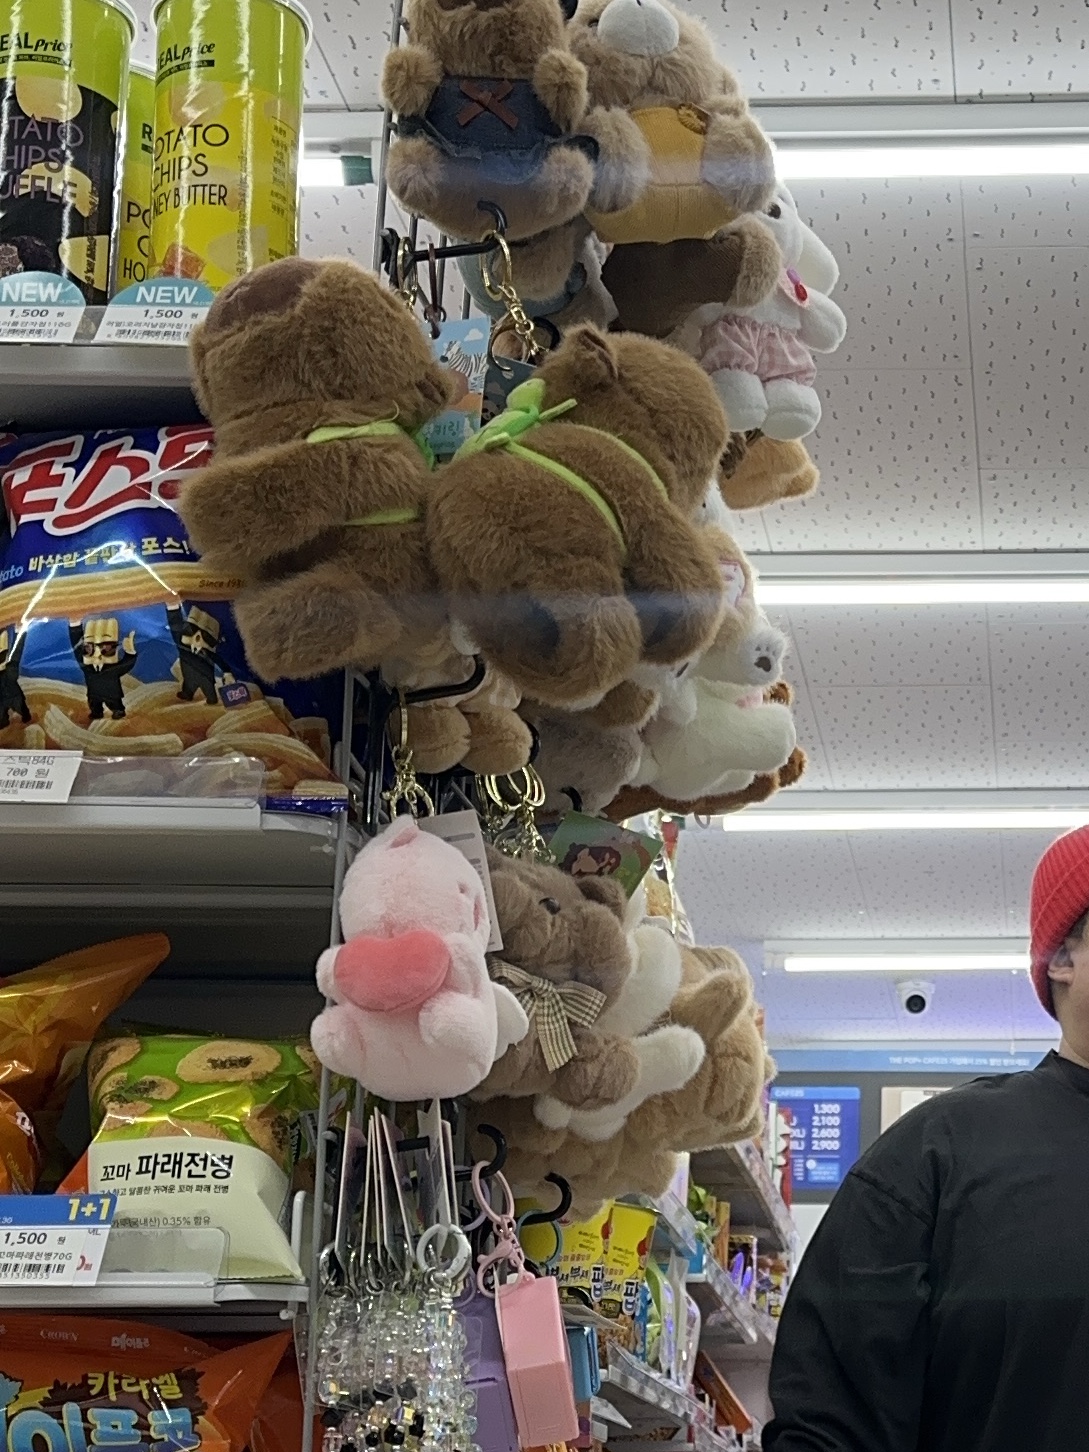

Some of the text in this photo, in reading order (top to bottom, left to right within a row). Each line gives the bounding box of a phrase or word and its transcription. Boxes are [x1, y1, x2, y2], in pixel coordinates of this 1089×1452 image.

[0, 31, 33, 52] EAL
[8, 112, 84, 148] TATO
[154, 123, 230, 162] OTATO
[5, 144, 64, 174] HIPS
[0, 174, 78, 203] UFFLE
[173, 183, 228, 211] BUTTER
[2, 282, 63, 303] NEW
[136, 286, 198, 304] NEW
[9, 308, 49, 319] 1,500
[143, 308, 183, 319] 1,500
[141, 536, 191, 556] 포스!
[226, 577, 246, 588] 198
[3, 755, 56, 767] 스틱84G
[35, 768, 50, 779] 원
[100, 1151, 235, 1182] 꼬마 파래전병
[177, 1184, 194, 1193] 꼬마
[194, 1184, 212, 1193] 파래
[213, 1184, 230, 1194] 전병
[68, 1197, 112, 1222] 1+1
[162, 1216, 191, 1226] 0.35%
[4, 1231, 48, 1246] 1,500
[87, 1370, 183, 1401] 카라멜
